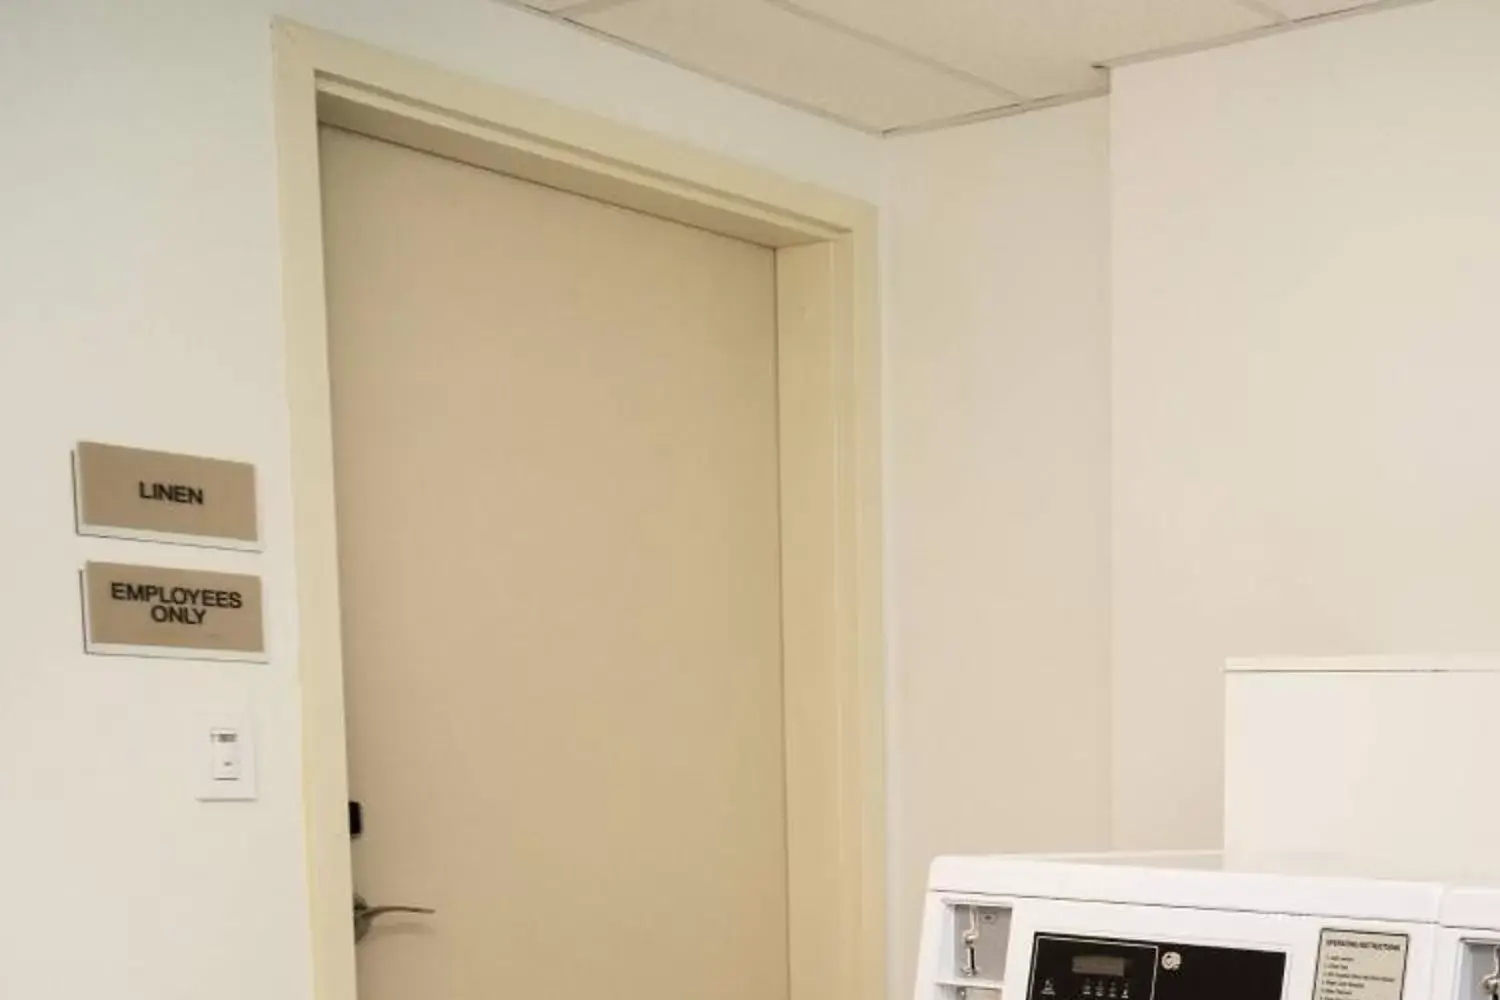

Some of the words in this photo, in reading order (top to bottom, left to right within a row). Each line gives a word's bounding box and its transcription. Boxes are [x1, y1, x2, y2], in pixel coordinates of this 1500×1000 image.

[139, 481, 204, 505] LINEN
[110, 582, 242, 608] EMPLOYEES
[150, 604, 206, 625] ONLY
